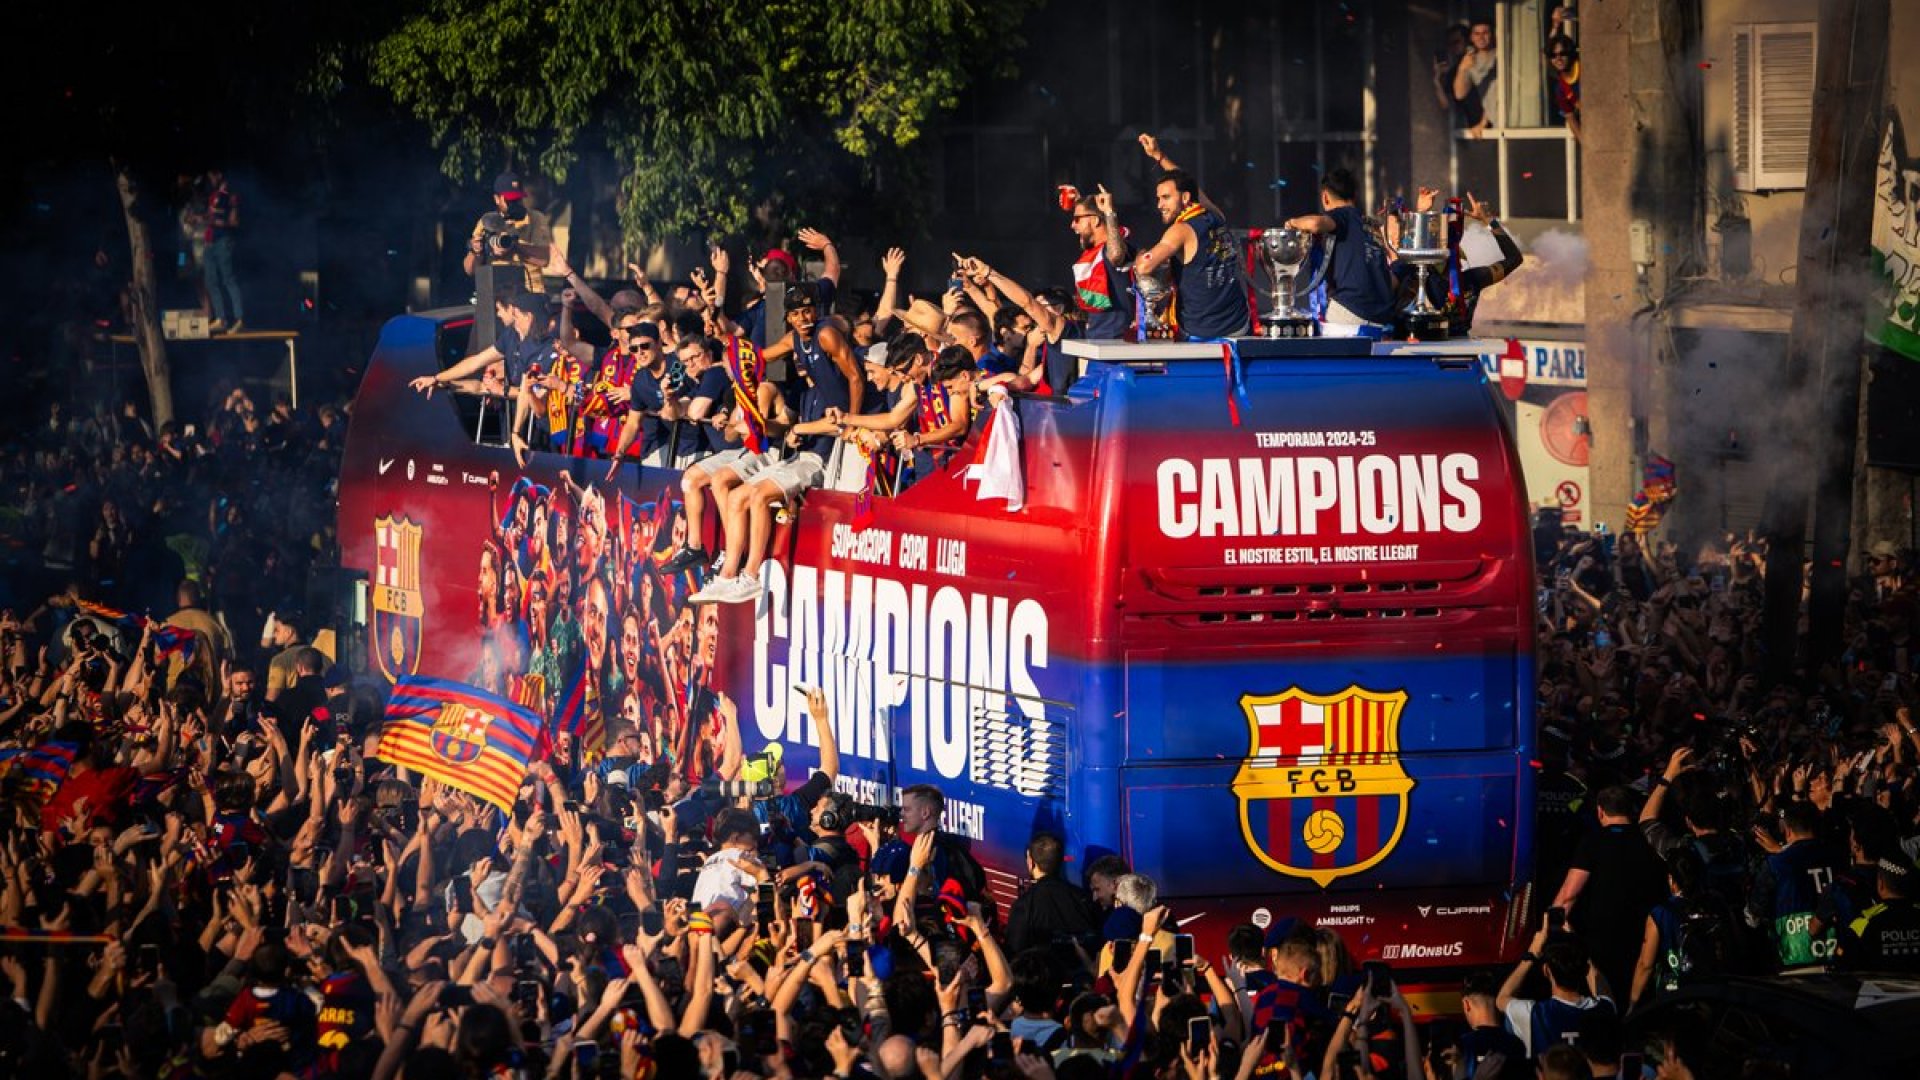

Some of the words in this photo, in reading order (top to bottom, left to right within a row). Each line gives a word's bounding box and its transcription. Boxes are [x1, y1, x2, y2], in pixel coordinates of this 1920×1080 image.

[1255, 433, 1325, 448] TEMPORADA
[1326, 431, 1376, 446] 2024-25
[1156, 452, 1482, 539] CAMPIONS
[831, 522, 892, 566] SUPERCOPA
[899, 532, 928, 571] COPA
[936, 537, 966, 577] LLIGA
[1224, 548, 1237, 564] EL
[1239, 548, 1283, 563] NOSTRE
[1285, 547, 1319, 565] ESTIL,
[1320, 546, 1333, 562] EL
[1335, 545, 1378, 562] NOSTRE
[1379, 543, 1419, 560] LLEGAT
[386, 589, 406, 612] FCB
[753, 558, 1049, 798] CAMPIONS
[1286, 768, 1357, 794] FCB
[949, 797, 984, 841] LLEGAT
[1330, 904, 1360, 913] PHILIPS
[1436, 905, 1491, 915] CUPRA
[1316, 916, 1364, 926] AMBILIGHT
